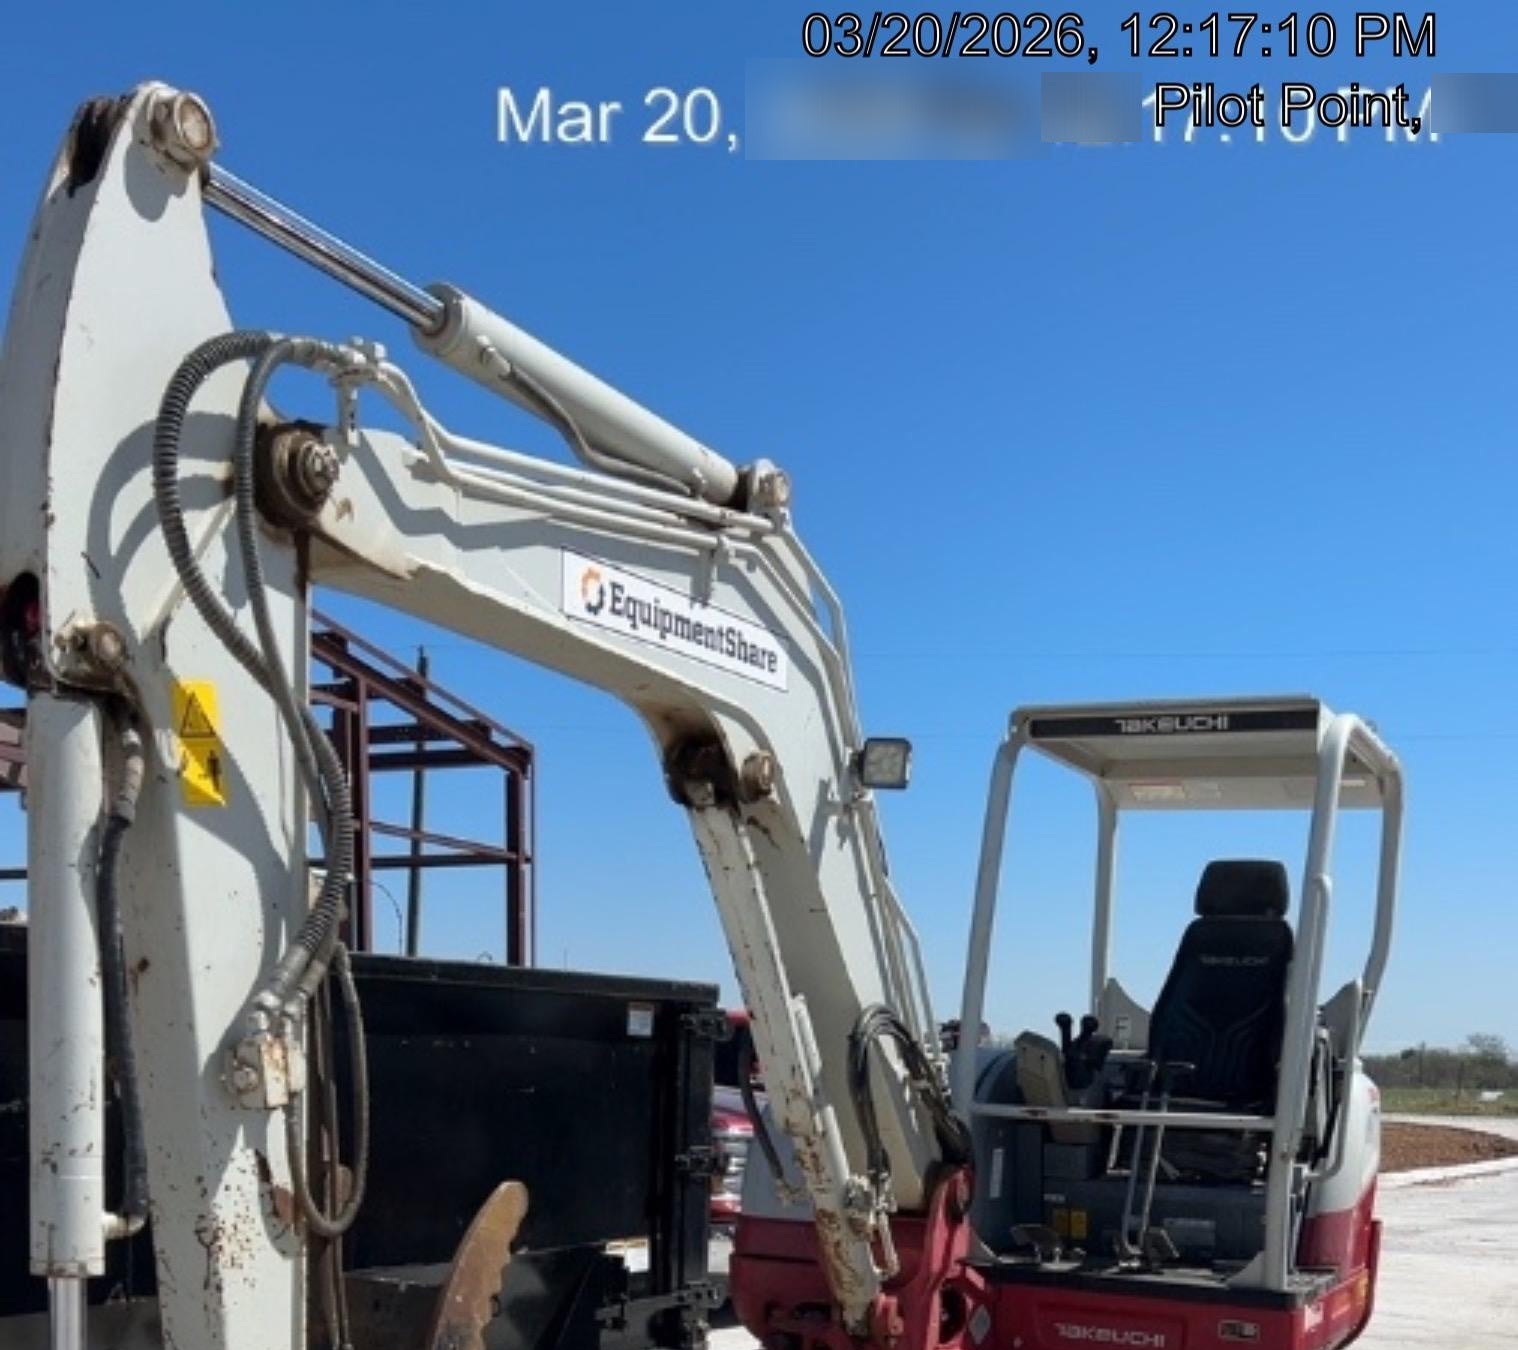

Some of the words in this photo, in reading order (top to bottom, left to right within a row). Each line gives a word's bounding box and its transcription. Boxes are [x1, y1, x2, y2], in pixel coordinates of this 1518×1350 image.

[609, 582, 778, 674] EquipmentShare
[1114, 715, 1229, 734] TAKEUCHI
[1053, 1322, 1166, 1348] TAKEUCHI
